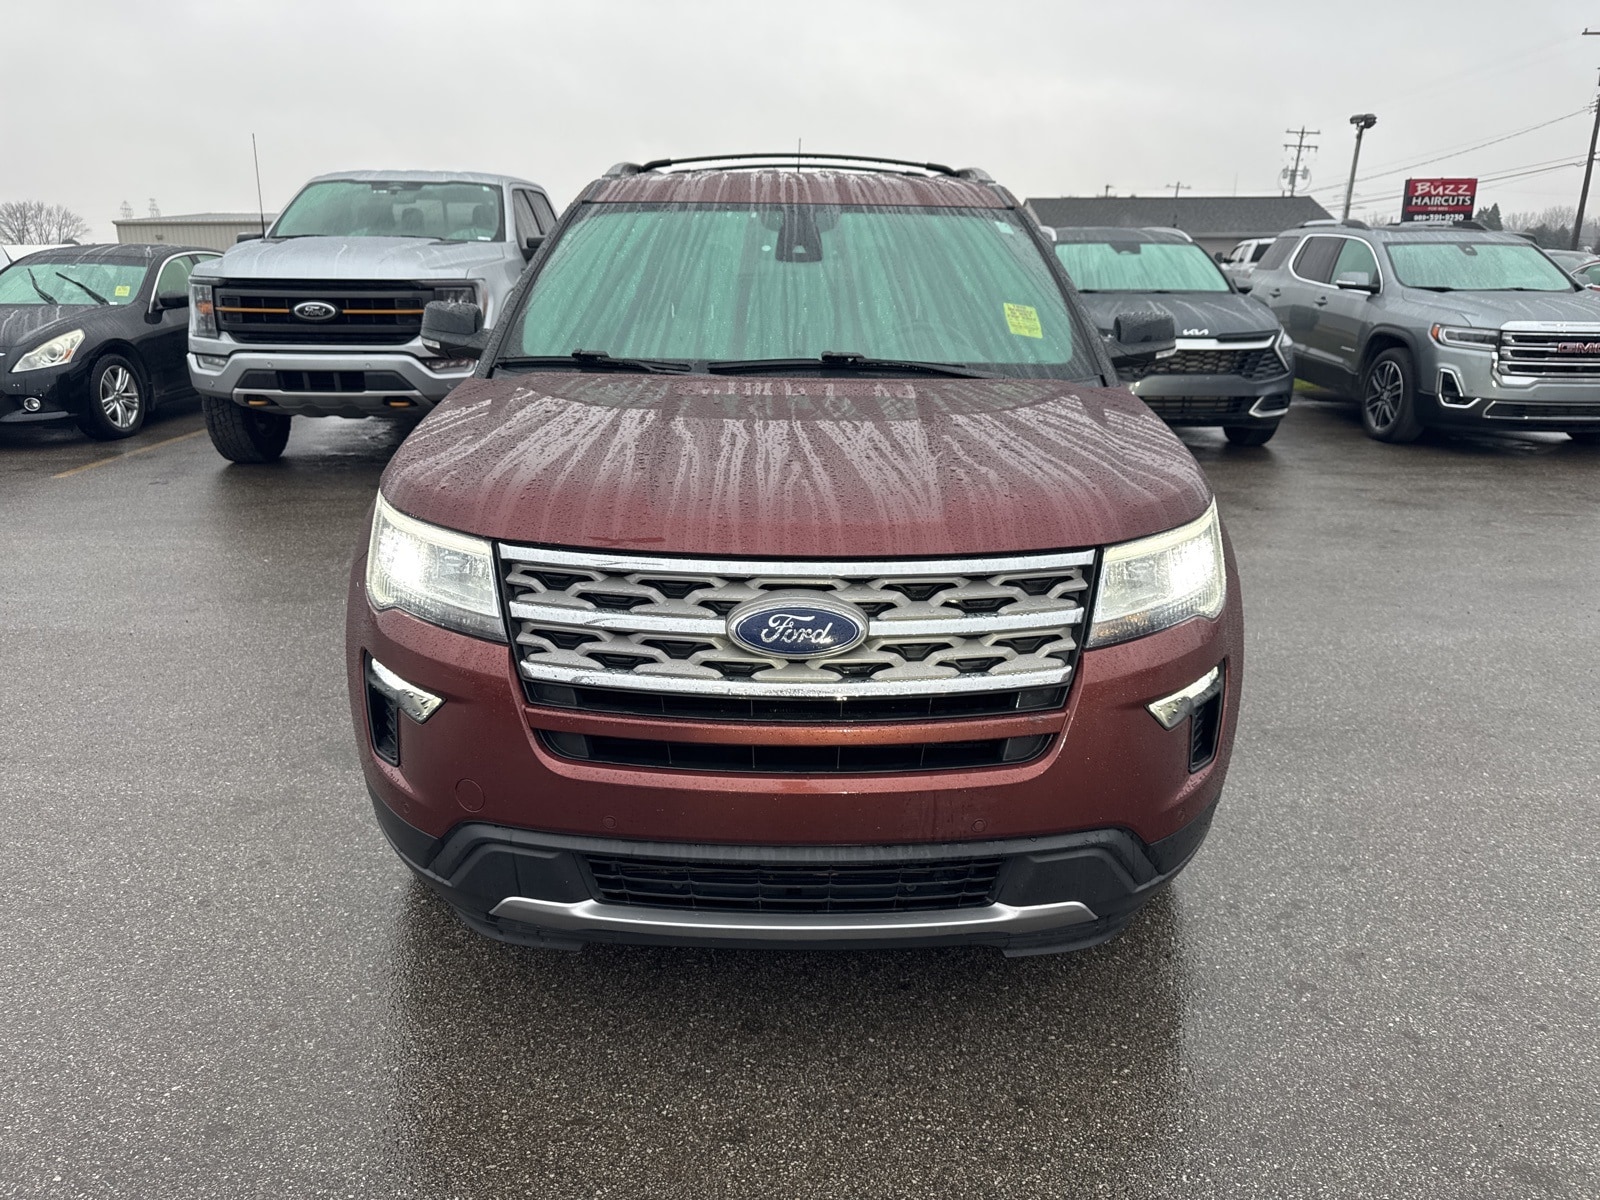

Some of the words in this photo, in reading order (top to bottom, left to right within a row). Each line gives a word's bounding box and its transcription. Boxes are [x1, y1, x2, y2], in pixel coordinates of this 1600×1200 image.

[1412, 196, 1471, 205] HAIRCUTS
[303, 305, 326, 316] Ford
[760, 613, 834, 644] Ford
